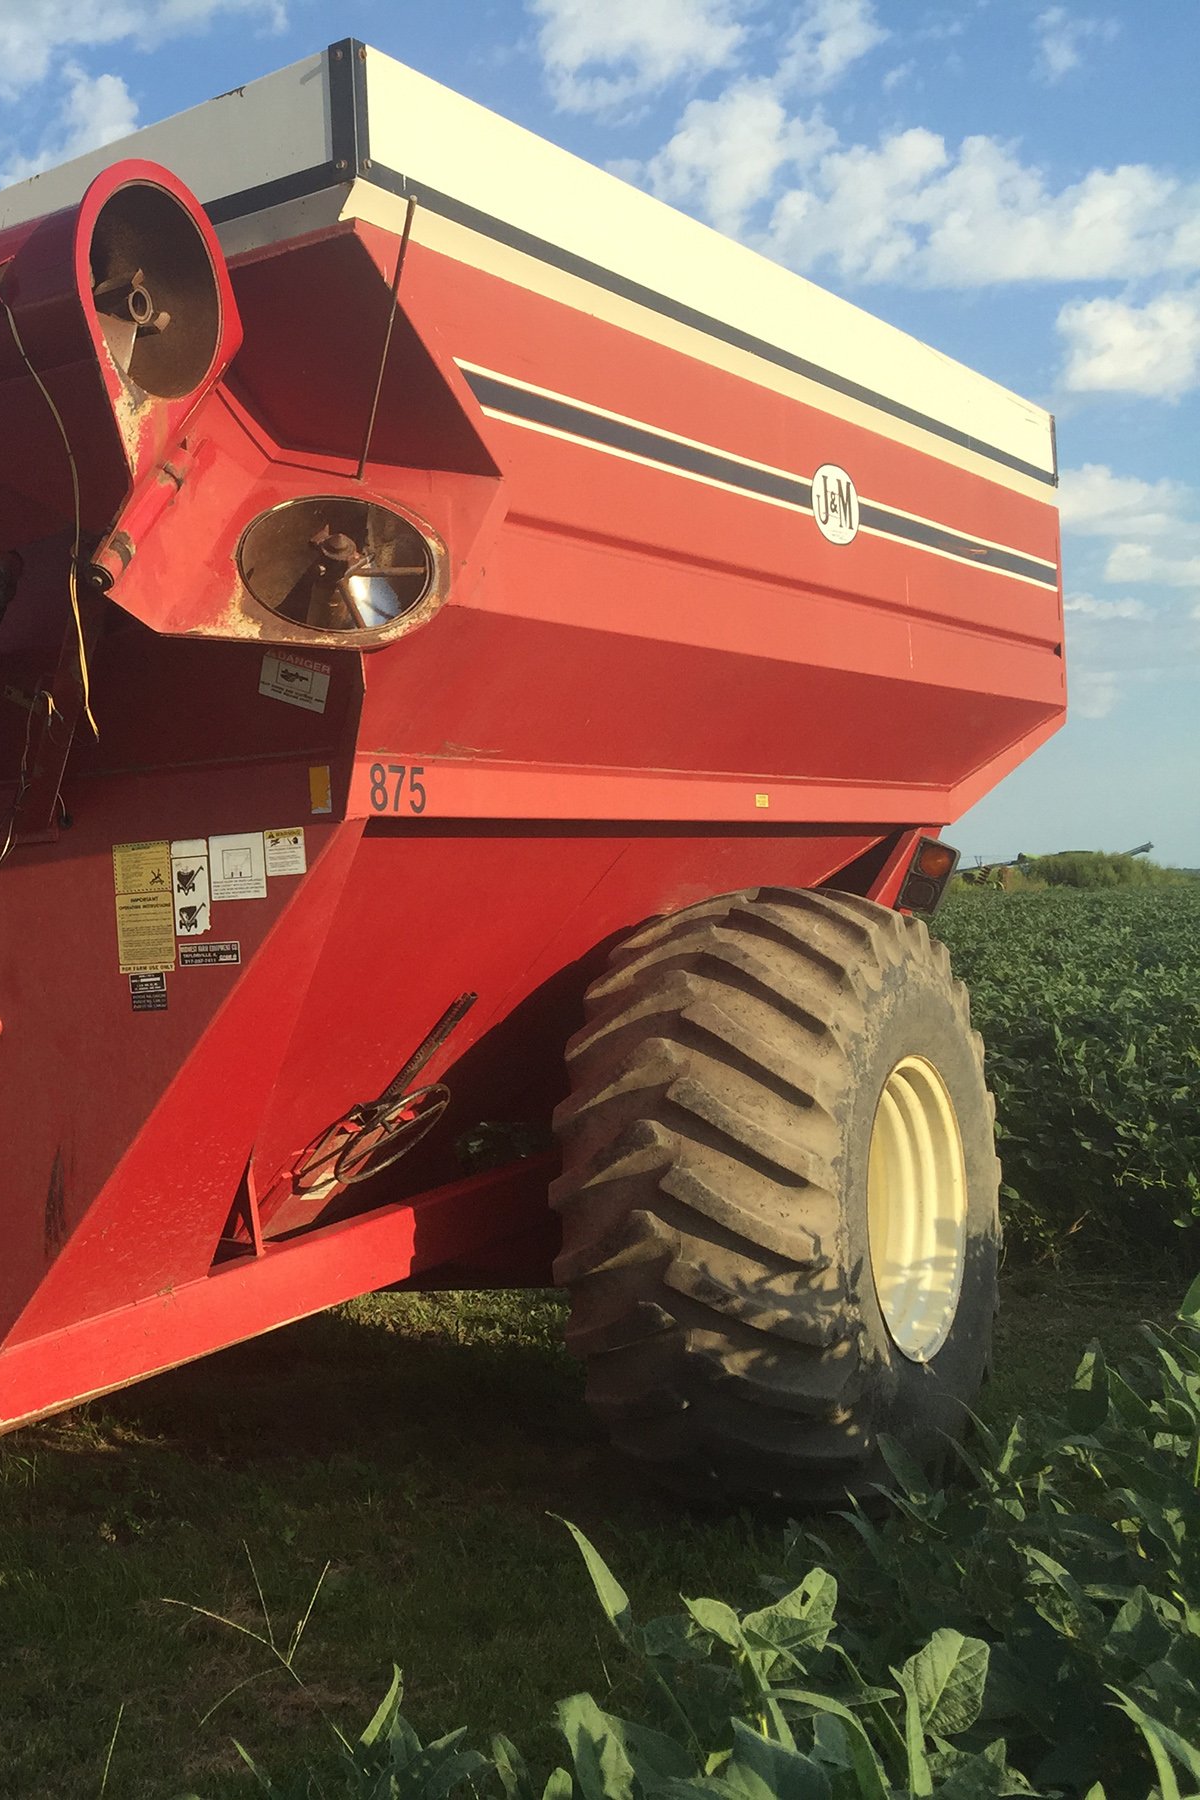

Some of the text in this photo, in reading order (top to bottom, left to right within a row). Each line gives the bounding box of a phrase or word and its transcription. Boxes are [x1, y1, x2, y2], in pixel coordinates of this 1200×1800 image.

[816, 475, 854, 530] J&M
[278, 651, 331, 674] DANGER
[369, 763, 426, 814] 875
